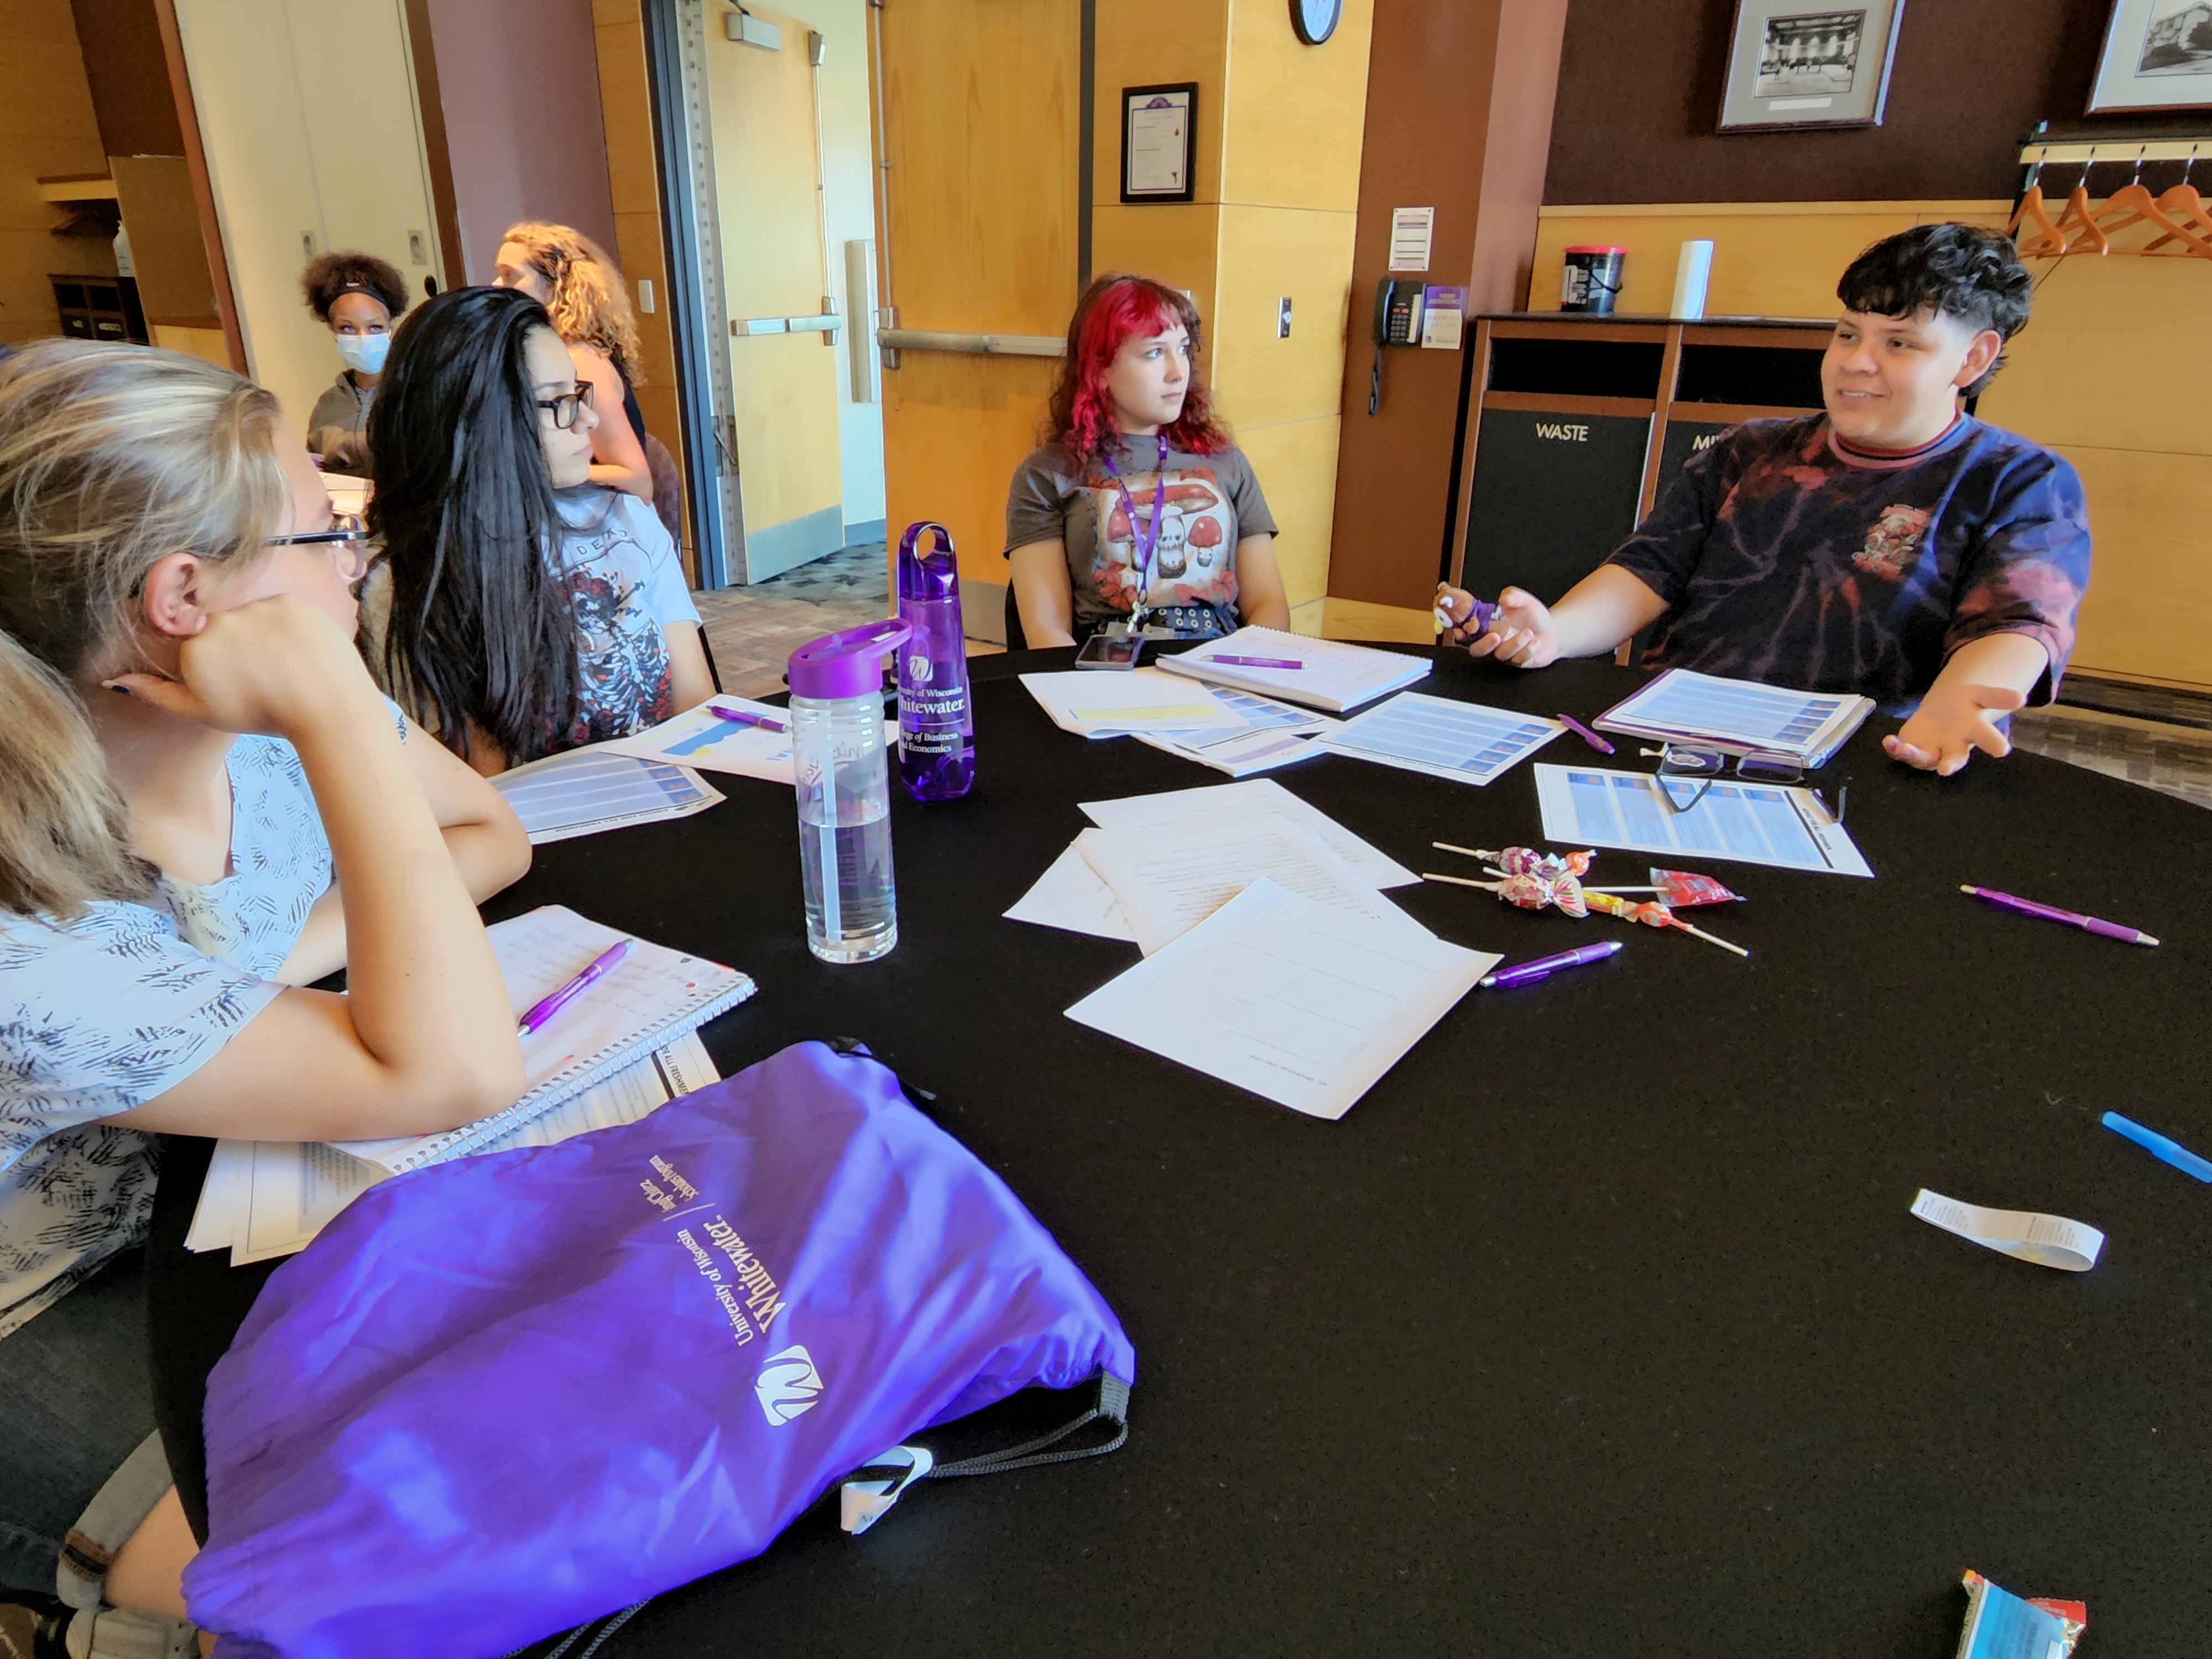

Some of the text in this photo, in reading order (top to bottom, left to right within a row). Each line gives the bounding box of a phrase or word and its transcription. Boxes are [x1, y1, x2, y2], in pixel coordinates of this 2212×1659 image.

[1536, 422, 1589, 442] WASTE
[926, 686, 963, 697] Wisconsin
[915, 733, 924, 743] of
[924, 733, 958, 742] Business
[909, 743, 952, 753] Economics
[664, 1055, 675, 1066] ALL
[701, 1266, 721, 1282] of
[714, 1284, 753, 1347] University
